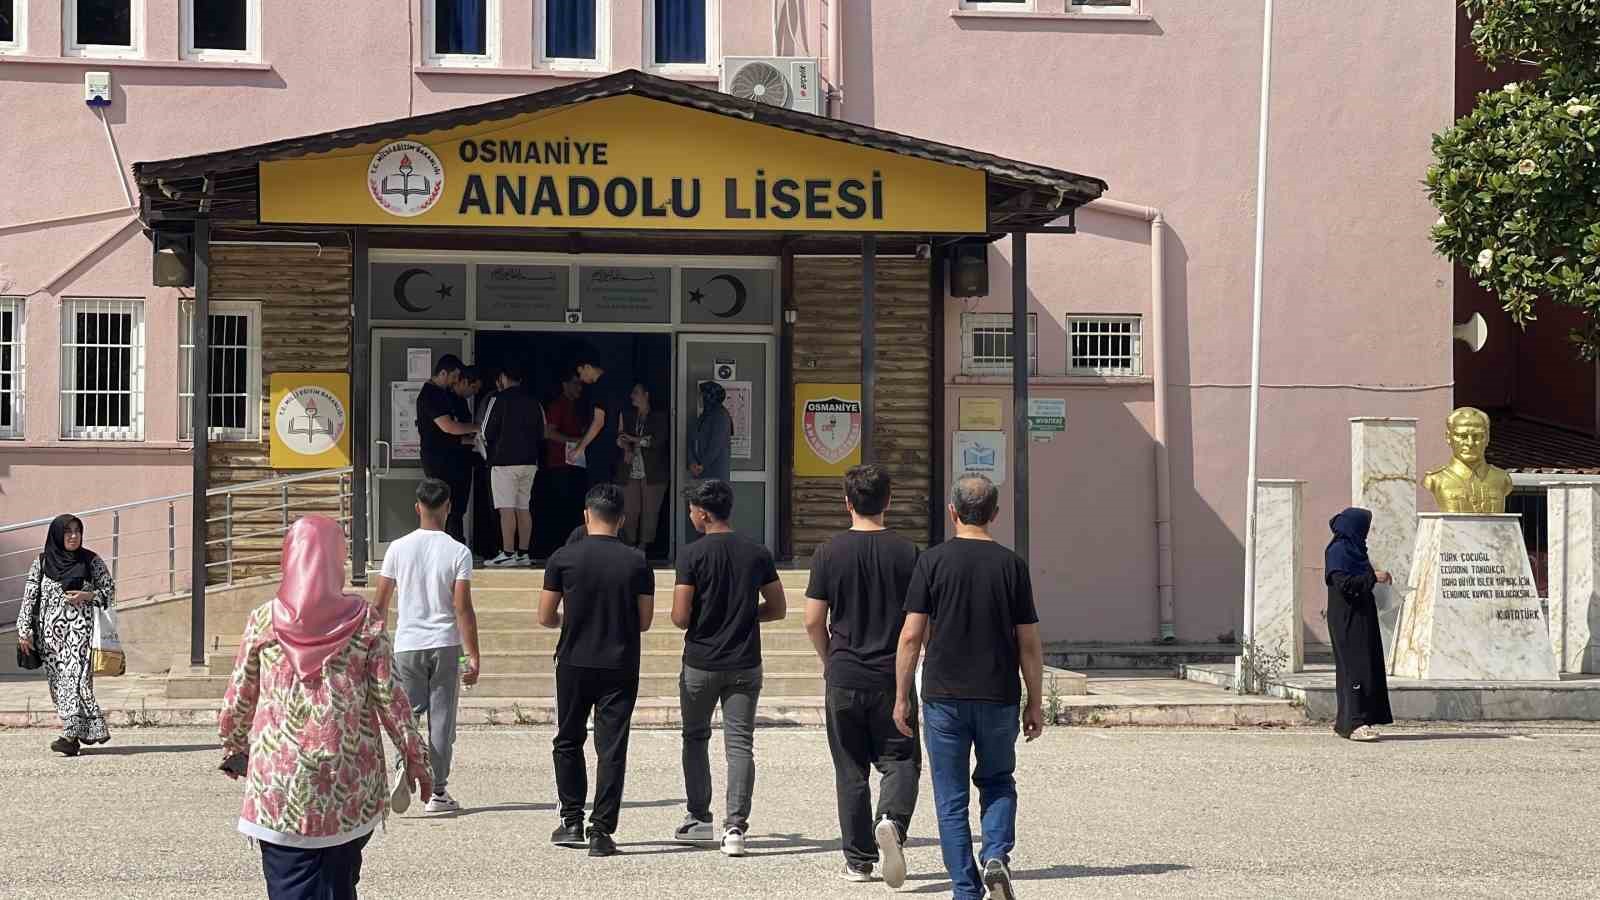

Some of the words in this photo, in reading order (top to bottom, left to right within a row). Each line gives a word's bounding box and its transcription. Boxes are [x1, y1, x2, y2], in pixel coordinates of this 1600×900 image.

[459, 135, 608, 165] OSMANİYE
[458, 173, 700, 218] ANADOLU
[724, 168, 884, 219] LİSESİ
[808, 402, 857, 412] OSMANİYE
[1440, 551, 1458, 561] TÜRK
